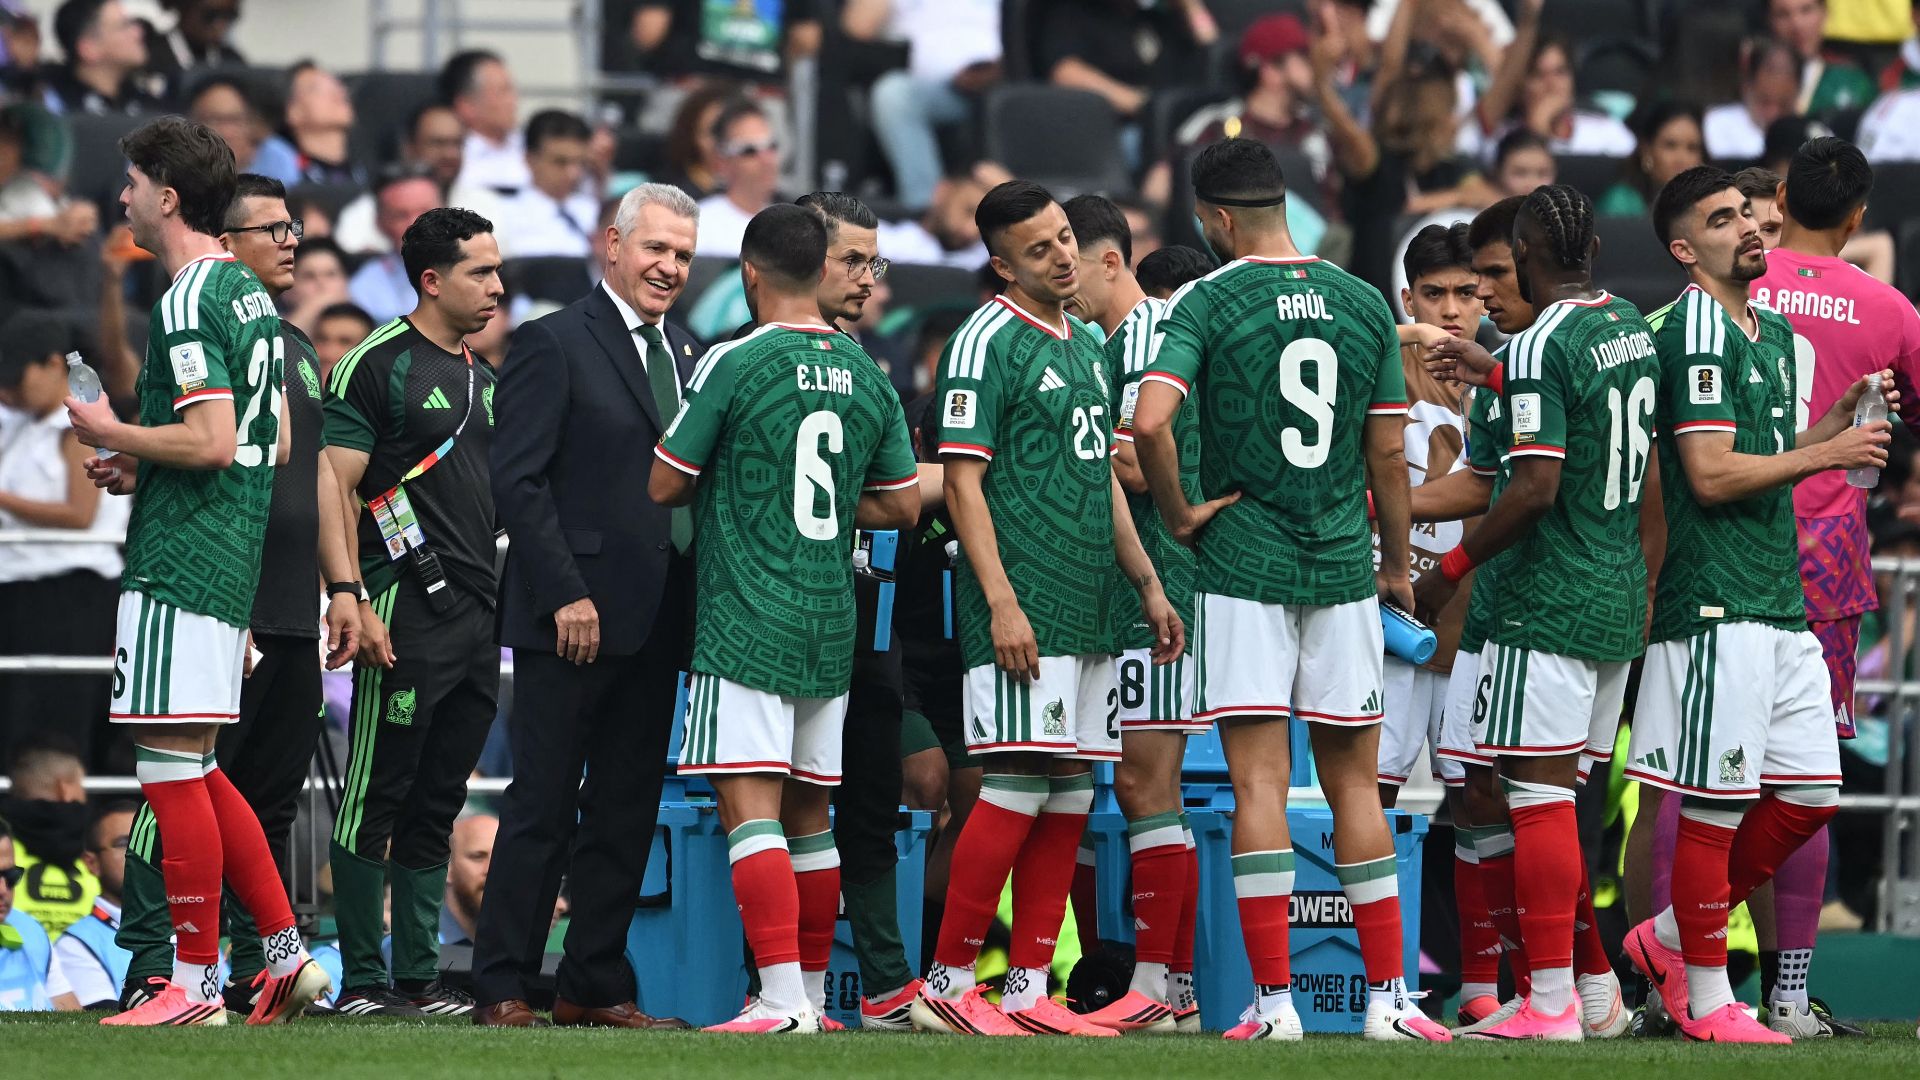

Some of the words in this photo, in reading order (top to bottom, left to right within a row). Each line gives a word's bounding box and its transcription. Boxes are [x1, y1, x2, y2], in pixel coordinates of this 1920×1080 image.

[1277, 288, 1333, 320] RAÚL
[797, 364, 852, 395] E.LIRA
[1279, 337, 1338, 468] 9
[1072, 405, 1106, 460] 25
[1517, 417, 1531, 425] PEACE
[1604, 376, 1655, 511] 16
[794, 410, 844, 541] 6
[1120, 658, 1145, 710] 8
[1106, 687, 1120, 740] 2
[1290, 973, 1345, 993] POWER
[1313, 994, 1345, 1013] ADE
